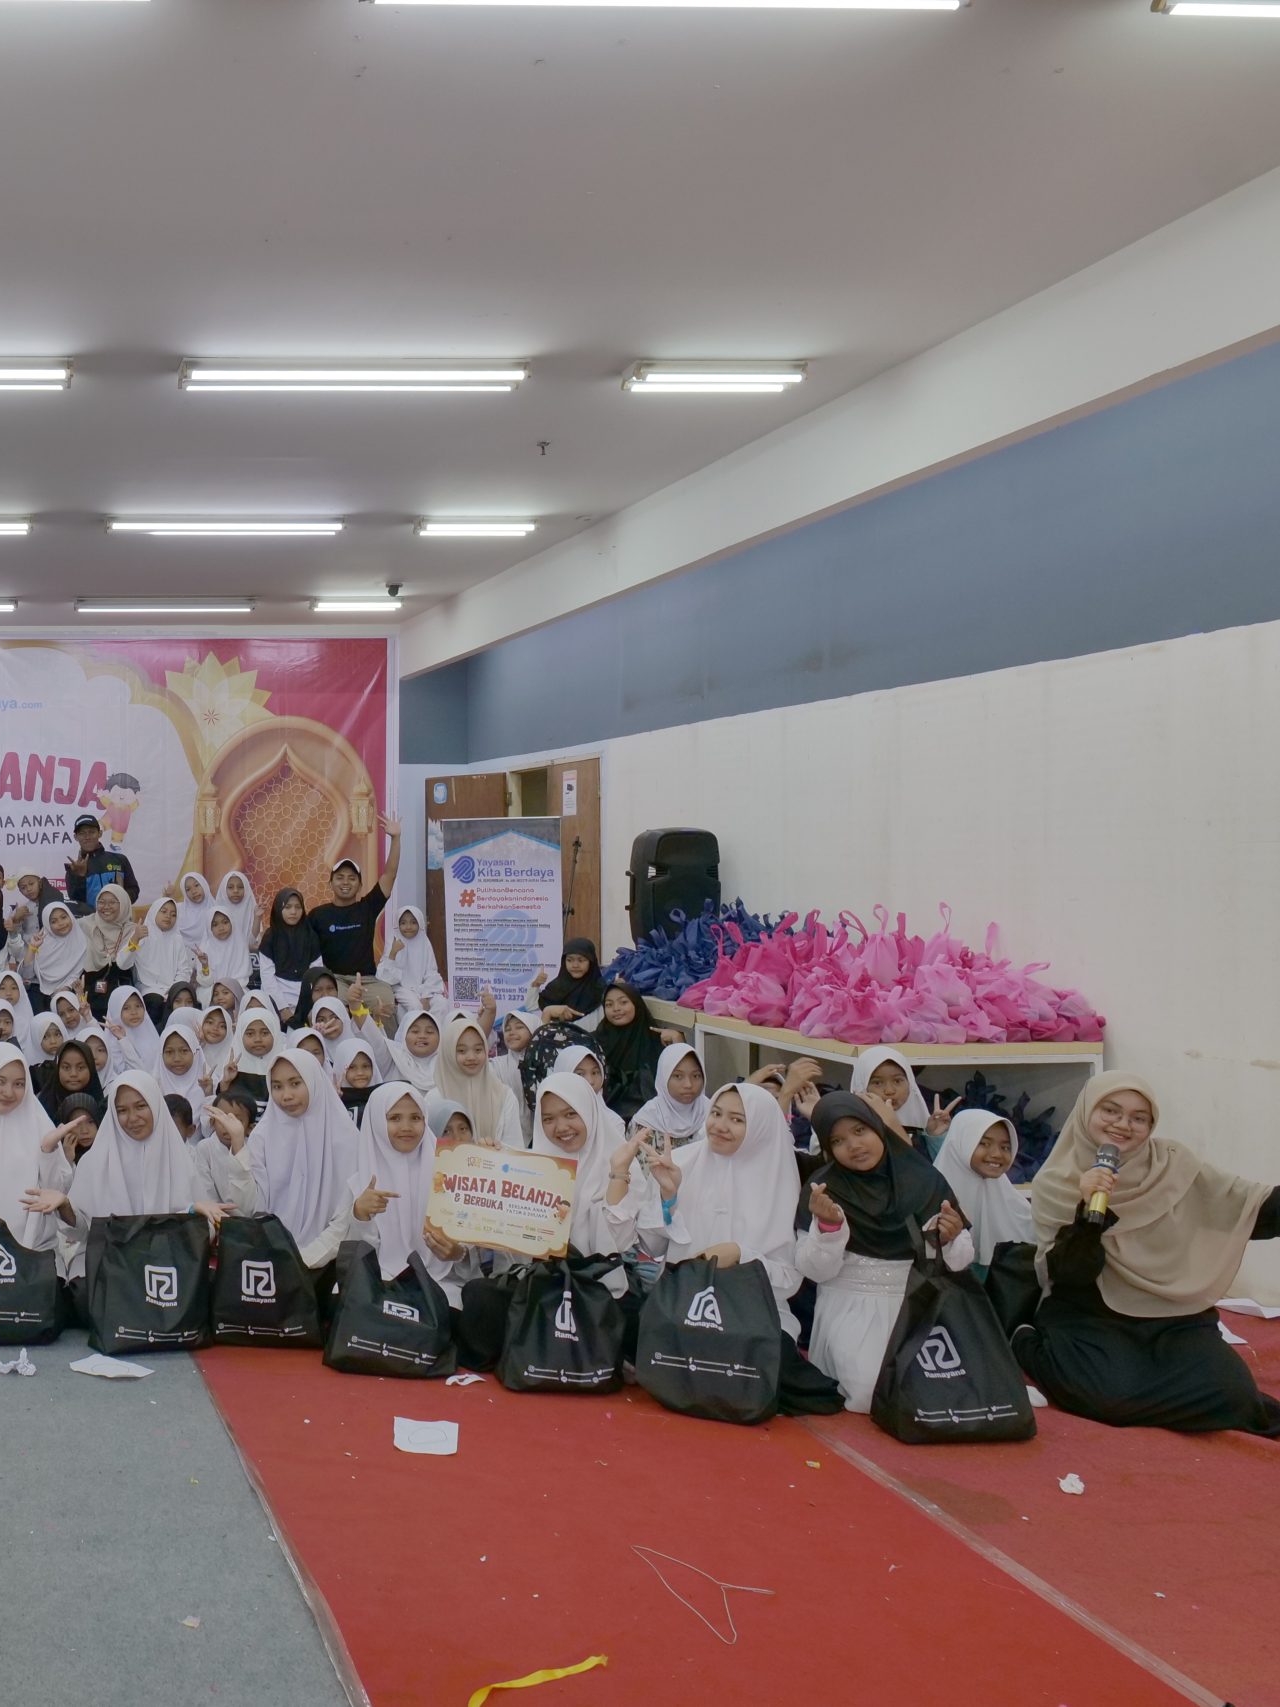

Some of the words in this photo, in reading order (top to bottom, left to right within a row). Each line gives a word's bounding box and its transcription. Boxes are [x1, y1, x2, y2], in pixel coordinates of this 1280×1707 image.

[21, 814, 66, 828] ANAK
[6, 831, 73, 846] DHUAFA
[477, 859, 516, 868] Yayasan
[477, 867, 501, 877] Kita
[505, 867, 554, 879] Berdaya
[443, 1173, 496, 1195] WISATA
[501, 1180, 562, 1211] BELANJA
[463, 1193, 504, 1211] BERBUKA
[146, 1296, 178, 1308] Ramayana
[241, 1295, 276, 1304] Ramayana
[923, 1368, 966, 1379] Ramayana
